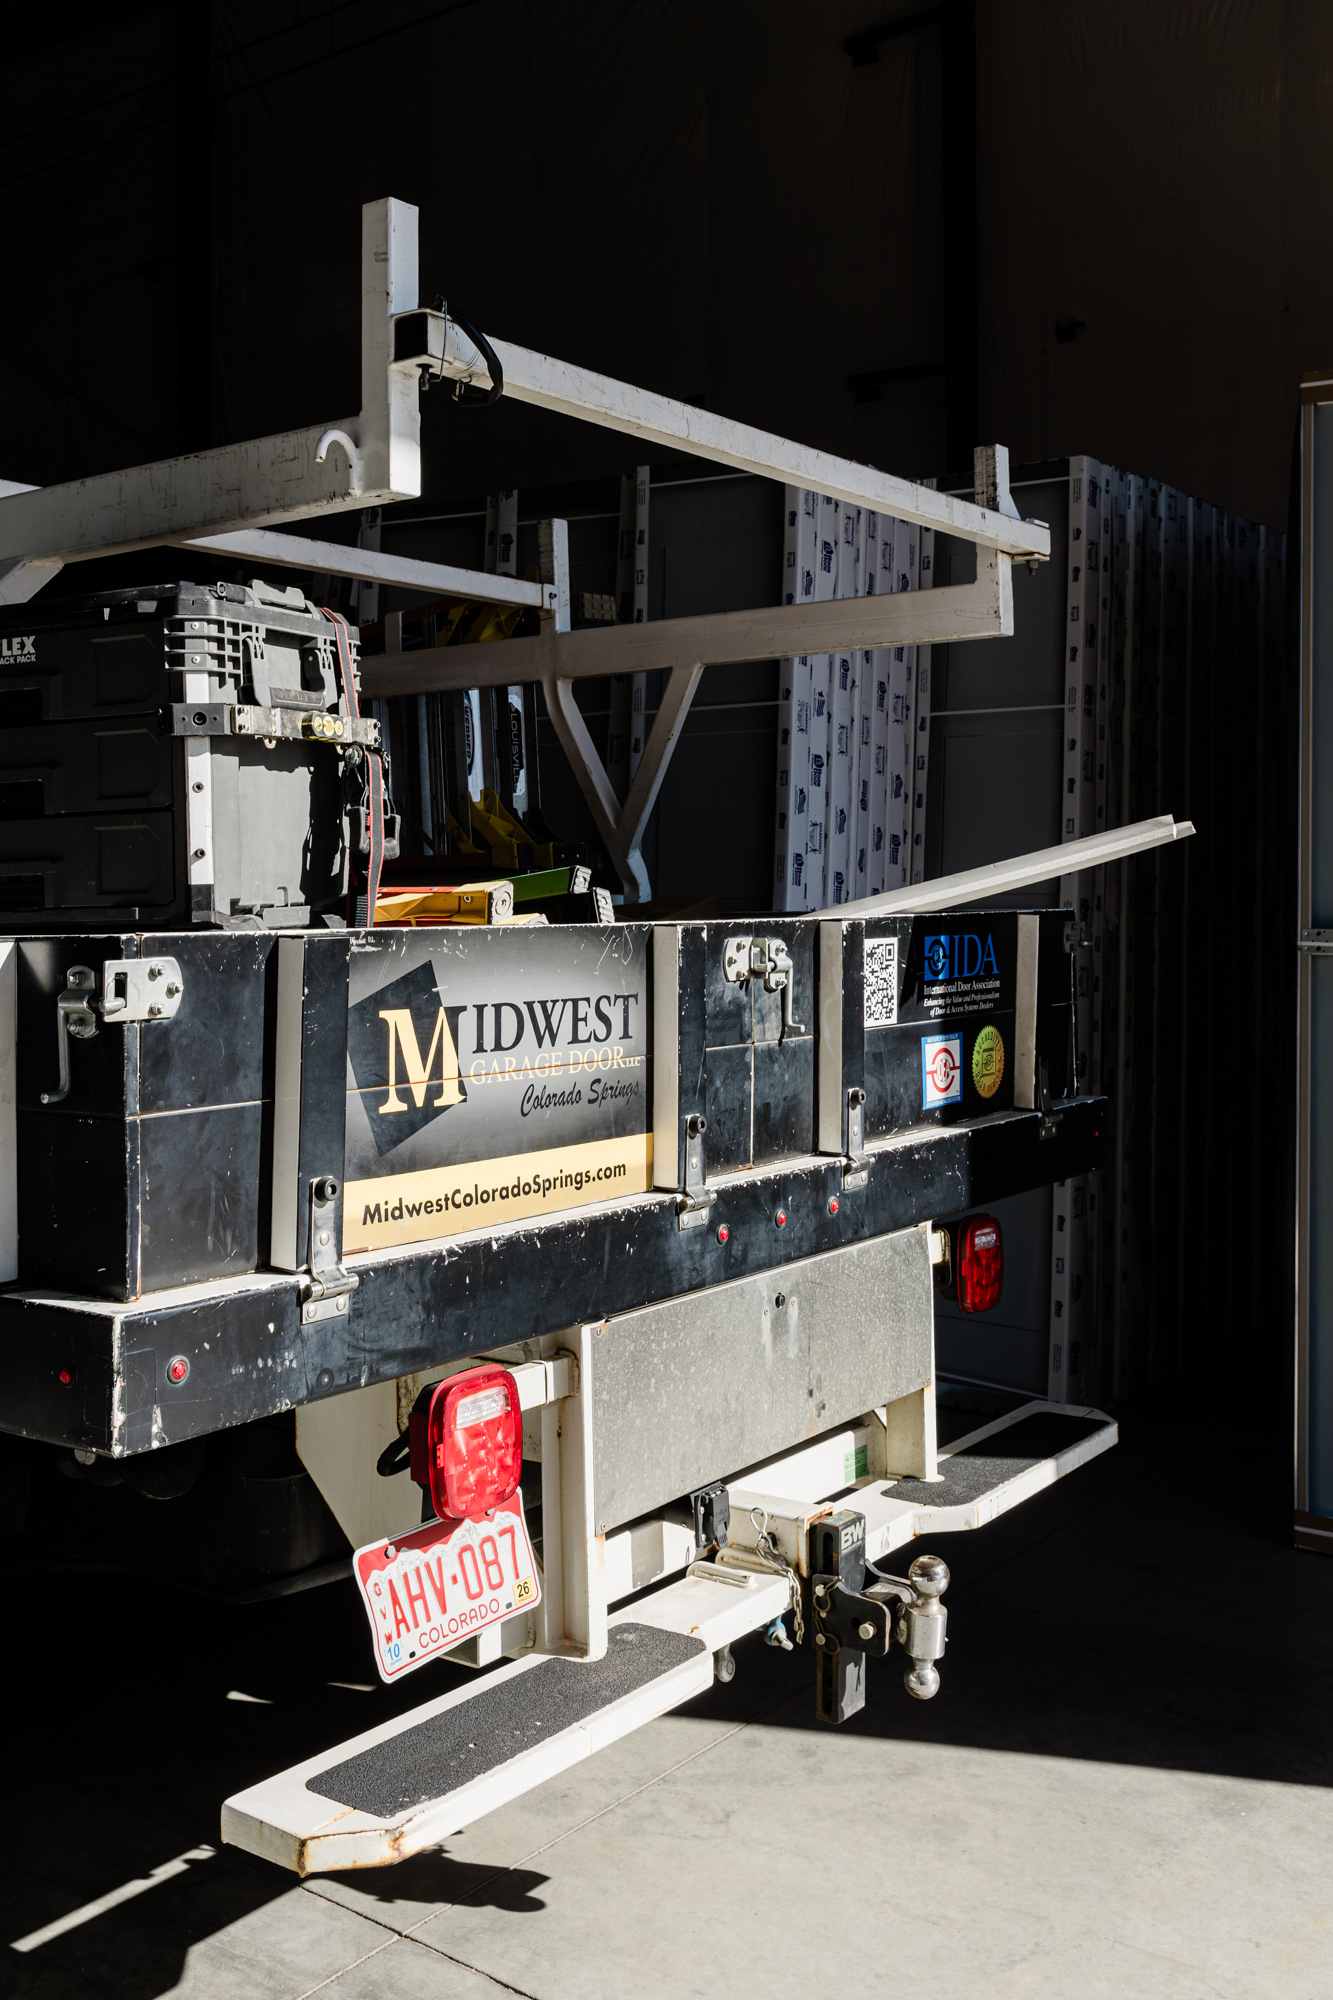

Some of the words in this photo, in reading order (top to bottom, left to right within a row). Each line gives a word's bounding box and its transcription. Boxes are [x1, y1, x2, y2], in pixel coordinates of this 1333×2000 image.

[0, 635, 36, 657] LEX
[16, 654, 36, 664] PACK
[952, 932, 999, 978] IDA
[923, 981, 957, 996] International
[958, 981, 972, 993] Door
[972, 978, 1001, 991] Association
[923, 997, 945, 1007] Enhancing
[935, 1006, 946, 1015] Door
[378, 992, 639, 1115] MIDWEST
[469, 1052, 564, 1085] GARAGE
[568, 1046, 626, 1075] DOOR
[520, 1083, 582, 1117] Colorado
[587, 1077, 640, 1108] Springs
[362, 1161, 627, 1226] MidwestColoradoSprings.com
[516, 1581, 530, 1598] 26
[418, 1598, 500, 1648] COLORADO
[387, 1643, 400, 1661] 10
